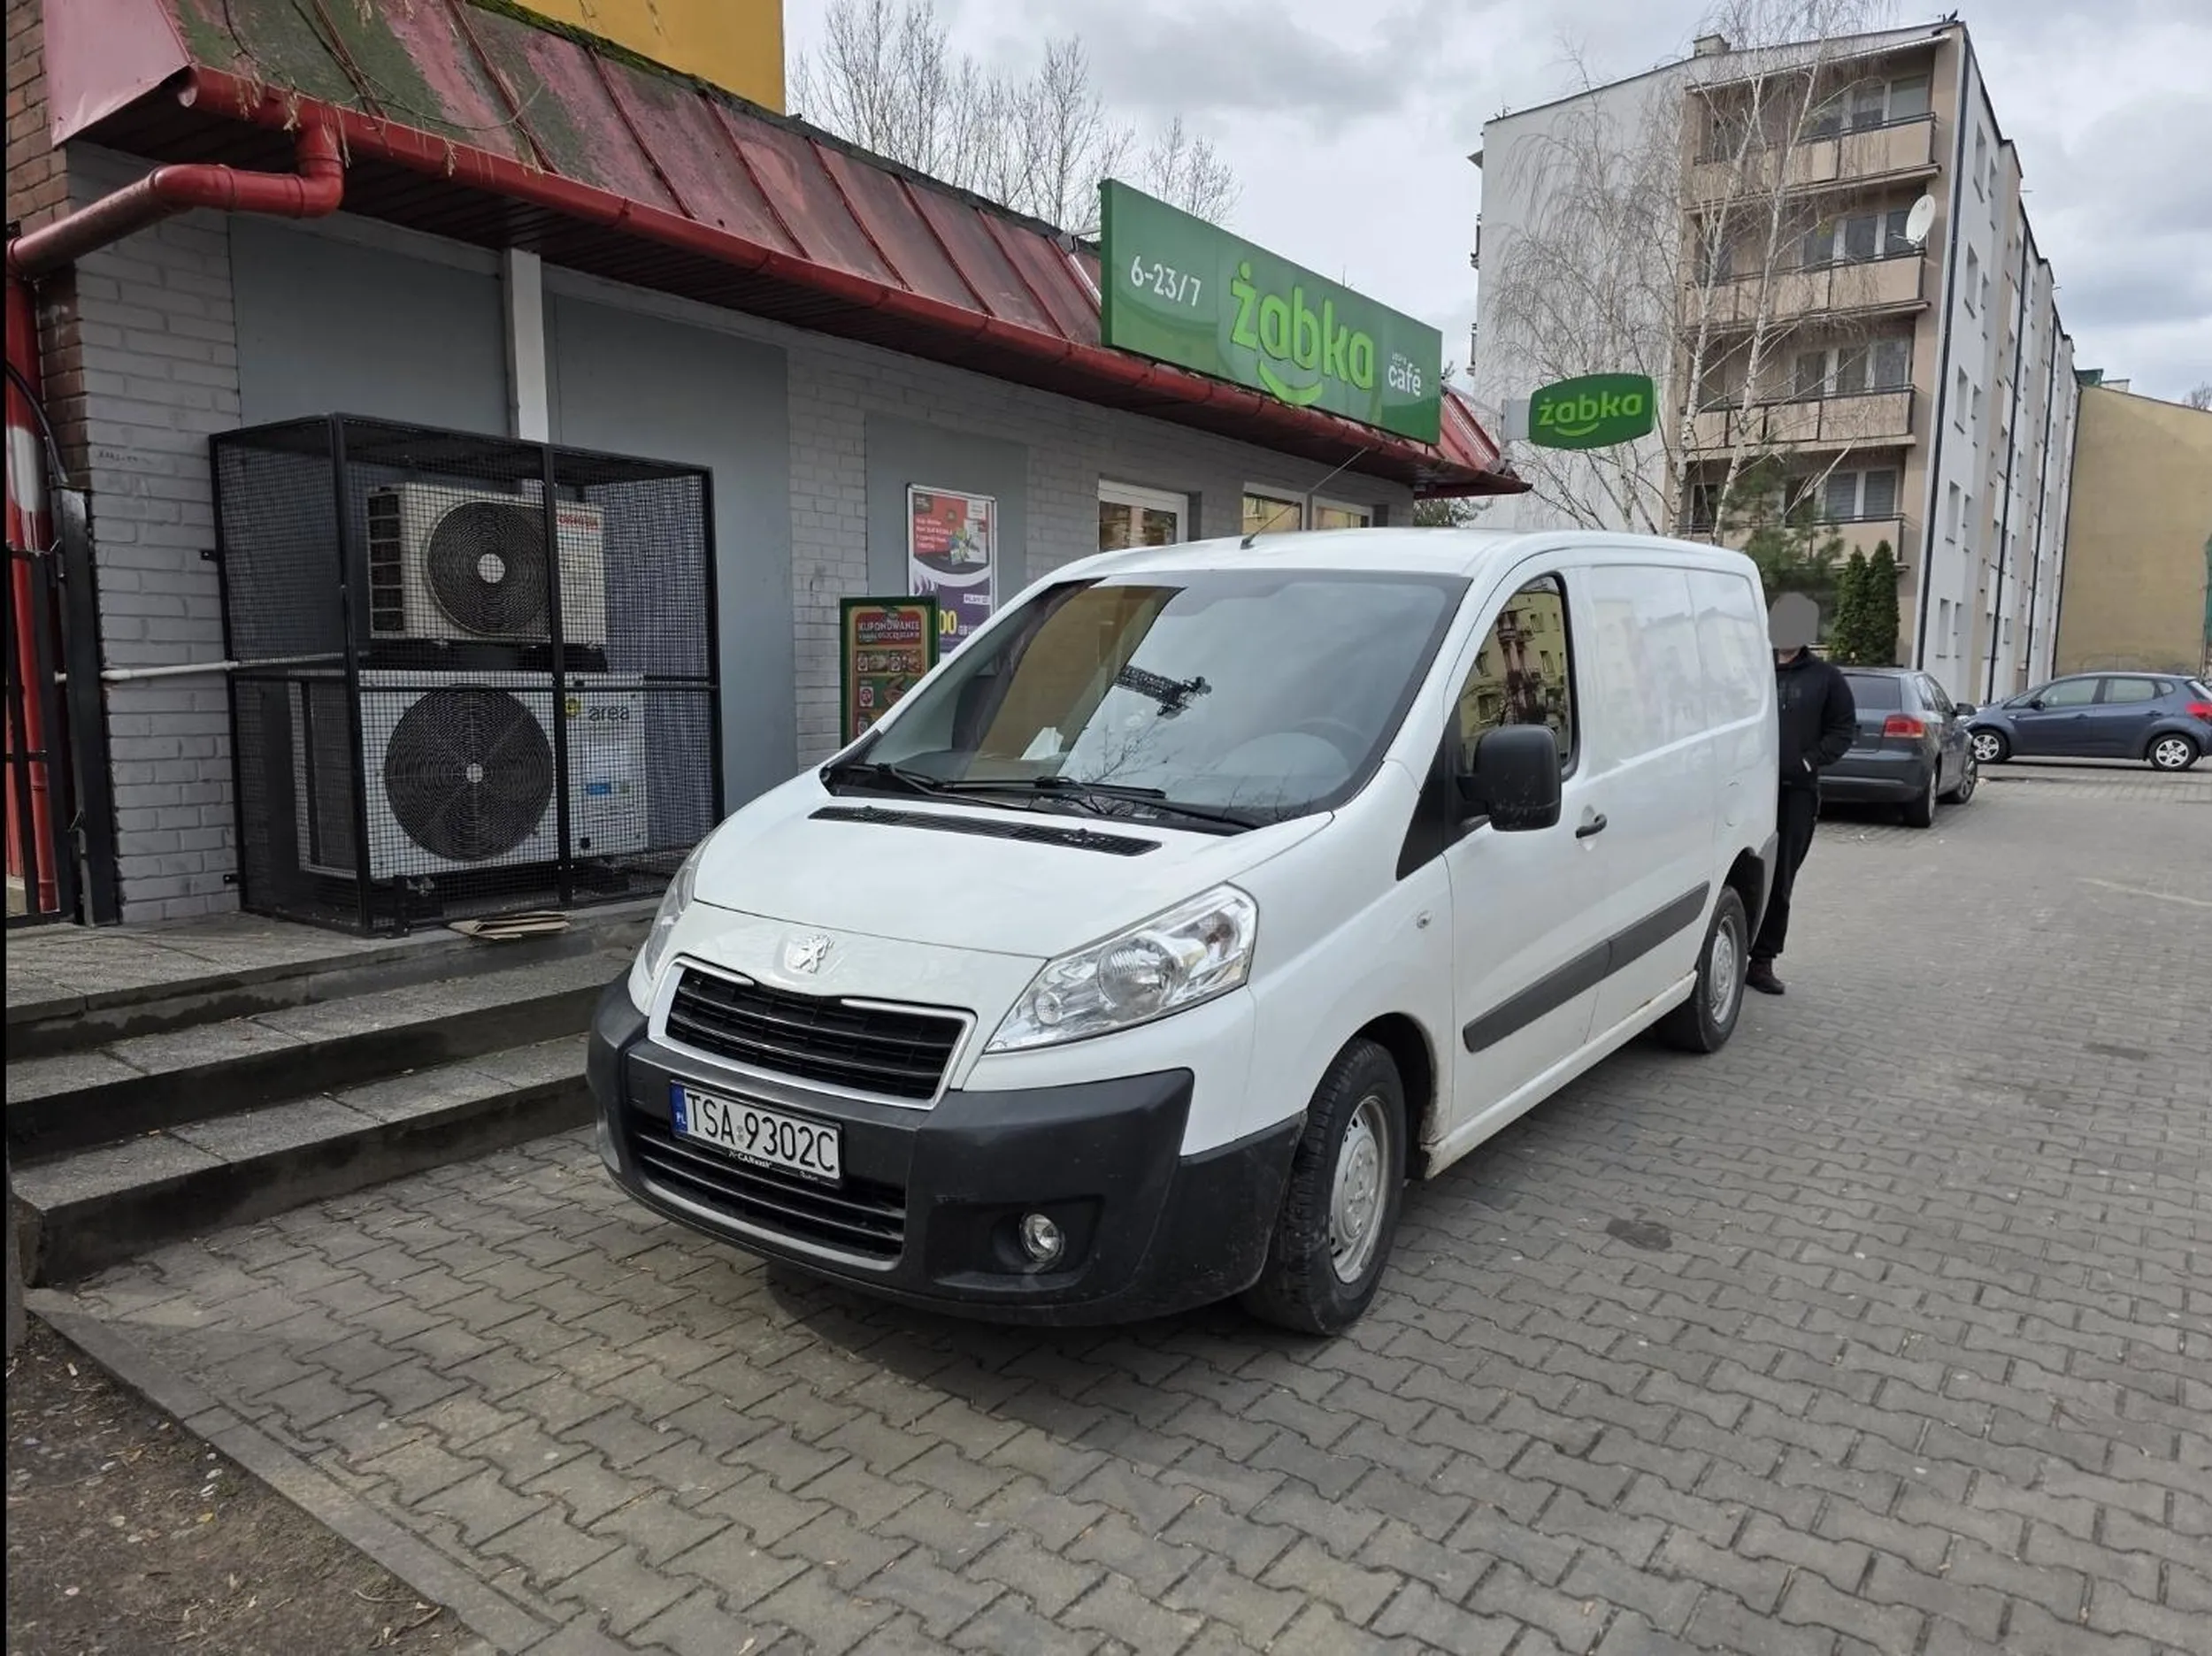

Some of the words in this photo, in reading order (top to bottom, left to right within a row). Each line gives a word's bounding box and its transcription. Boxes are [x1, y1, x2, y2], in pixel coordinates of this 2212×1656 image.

[1131, 256, 1202, 306] 6-23/7
[1231, 262, 1375, 390] żabka
[1388, 363, 1421, 397] café
[1538, 390, 1643, 426] żabka
[675, 1111, 687, 1124] PL
[686, 1092, 735, 1146] TSA
[744, 1112, 835, 1172] 9302C
